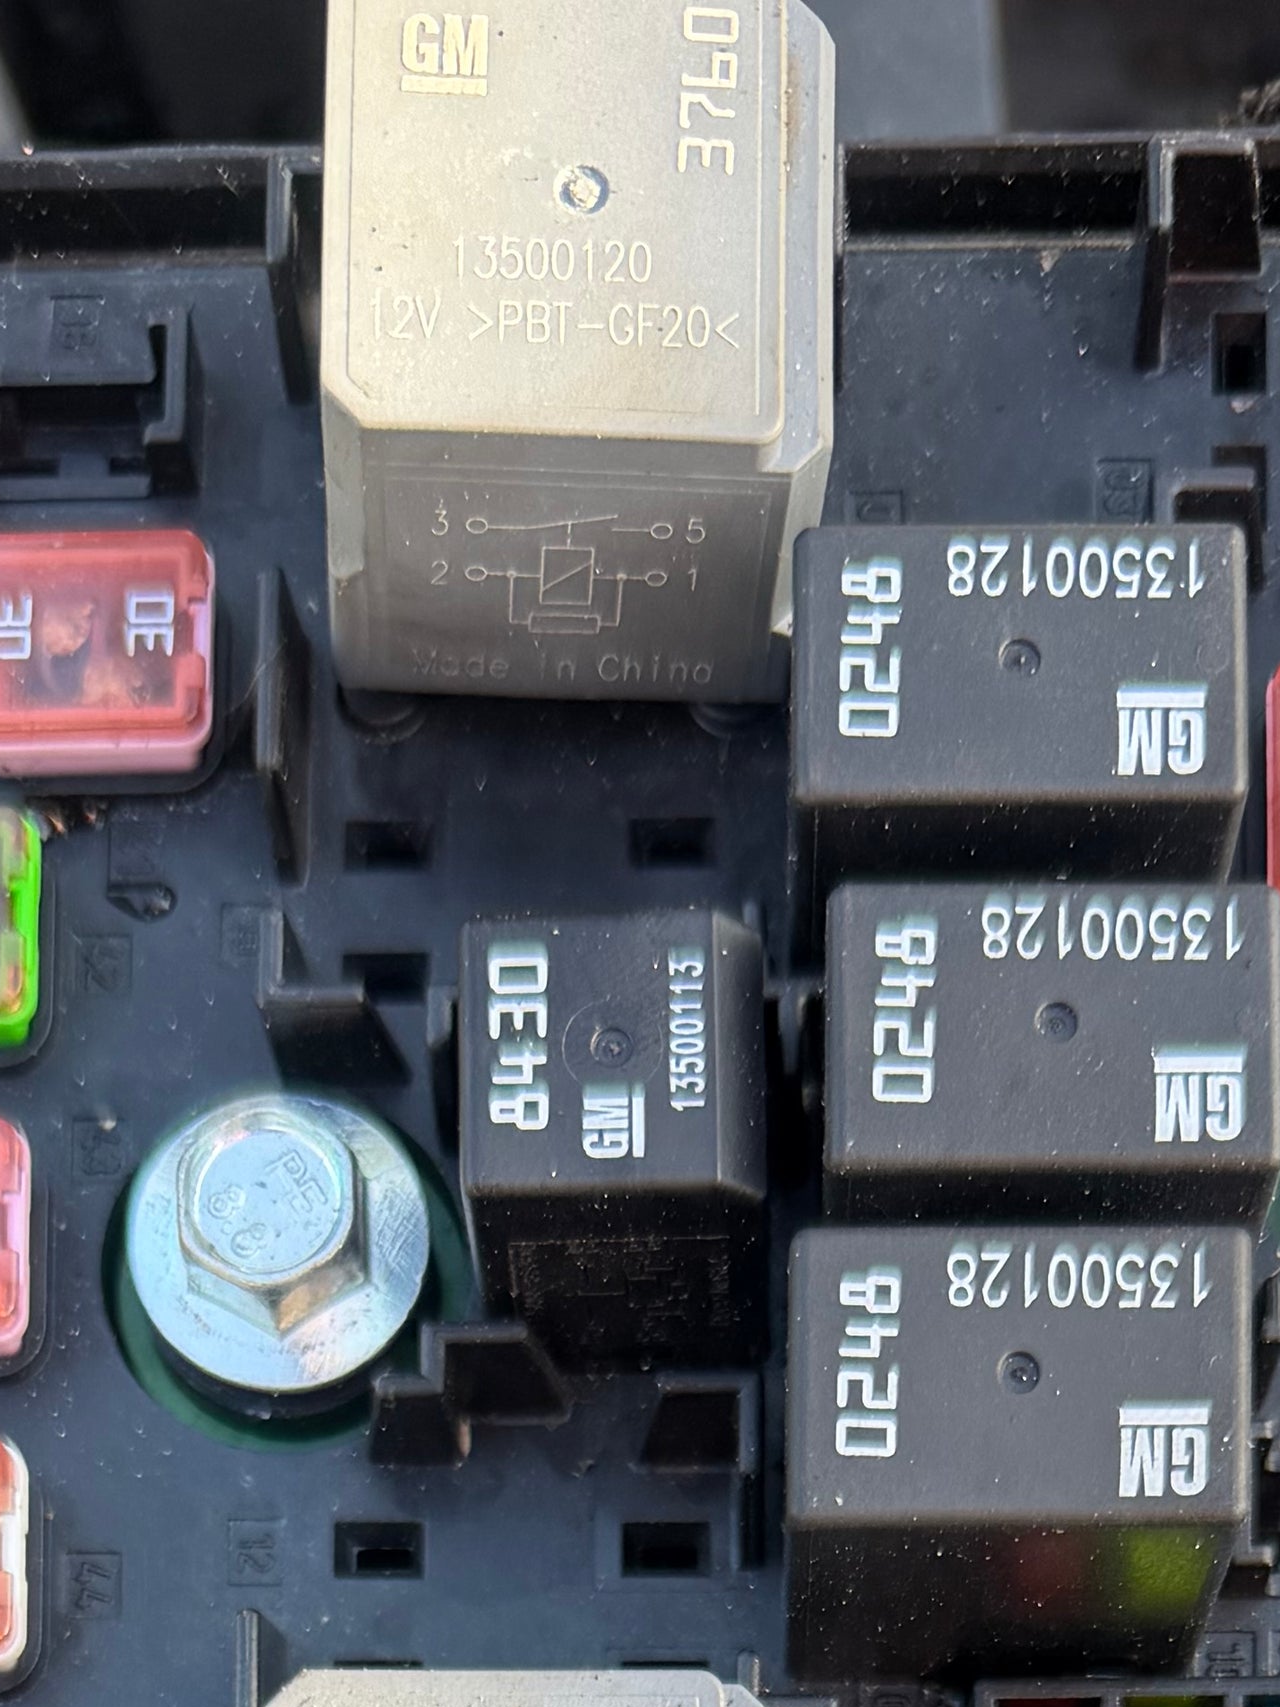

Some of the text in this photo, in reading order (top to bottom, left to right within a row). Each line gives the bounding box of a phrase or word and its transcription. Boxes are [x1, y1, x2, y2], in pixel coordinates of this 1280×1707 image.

[403, 16, 488, 76] GM
[678, 6, 740, 176] 3760
[453, 238, 652, 282] 13500120
[371, 297, 740, 349] 12V >PBT-GF20<
[947, 537, 1206, 598] 13500128
[125, 592, 175, 656] 30
[839, 558, 903, 738] 0248
[1117, 705, 1206, 775] GM
[981, 897, 1242, 961] 13500128
[489, 946, 549, 1131] 8430
[669, 949, 707, 1110] 13500113
[873, 923, 938, 1104] 0248
[583, 1086, 628, 1158] GM
[1155, 1075, 1242, 1142] GM
[948, 1247, 1210, 1309] 13500128
[838, 1271, 902, 1457] 0248
[1120, 1428, 1209, 1497] GM
